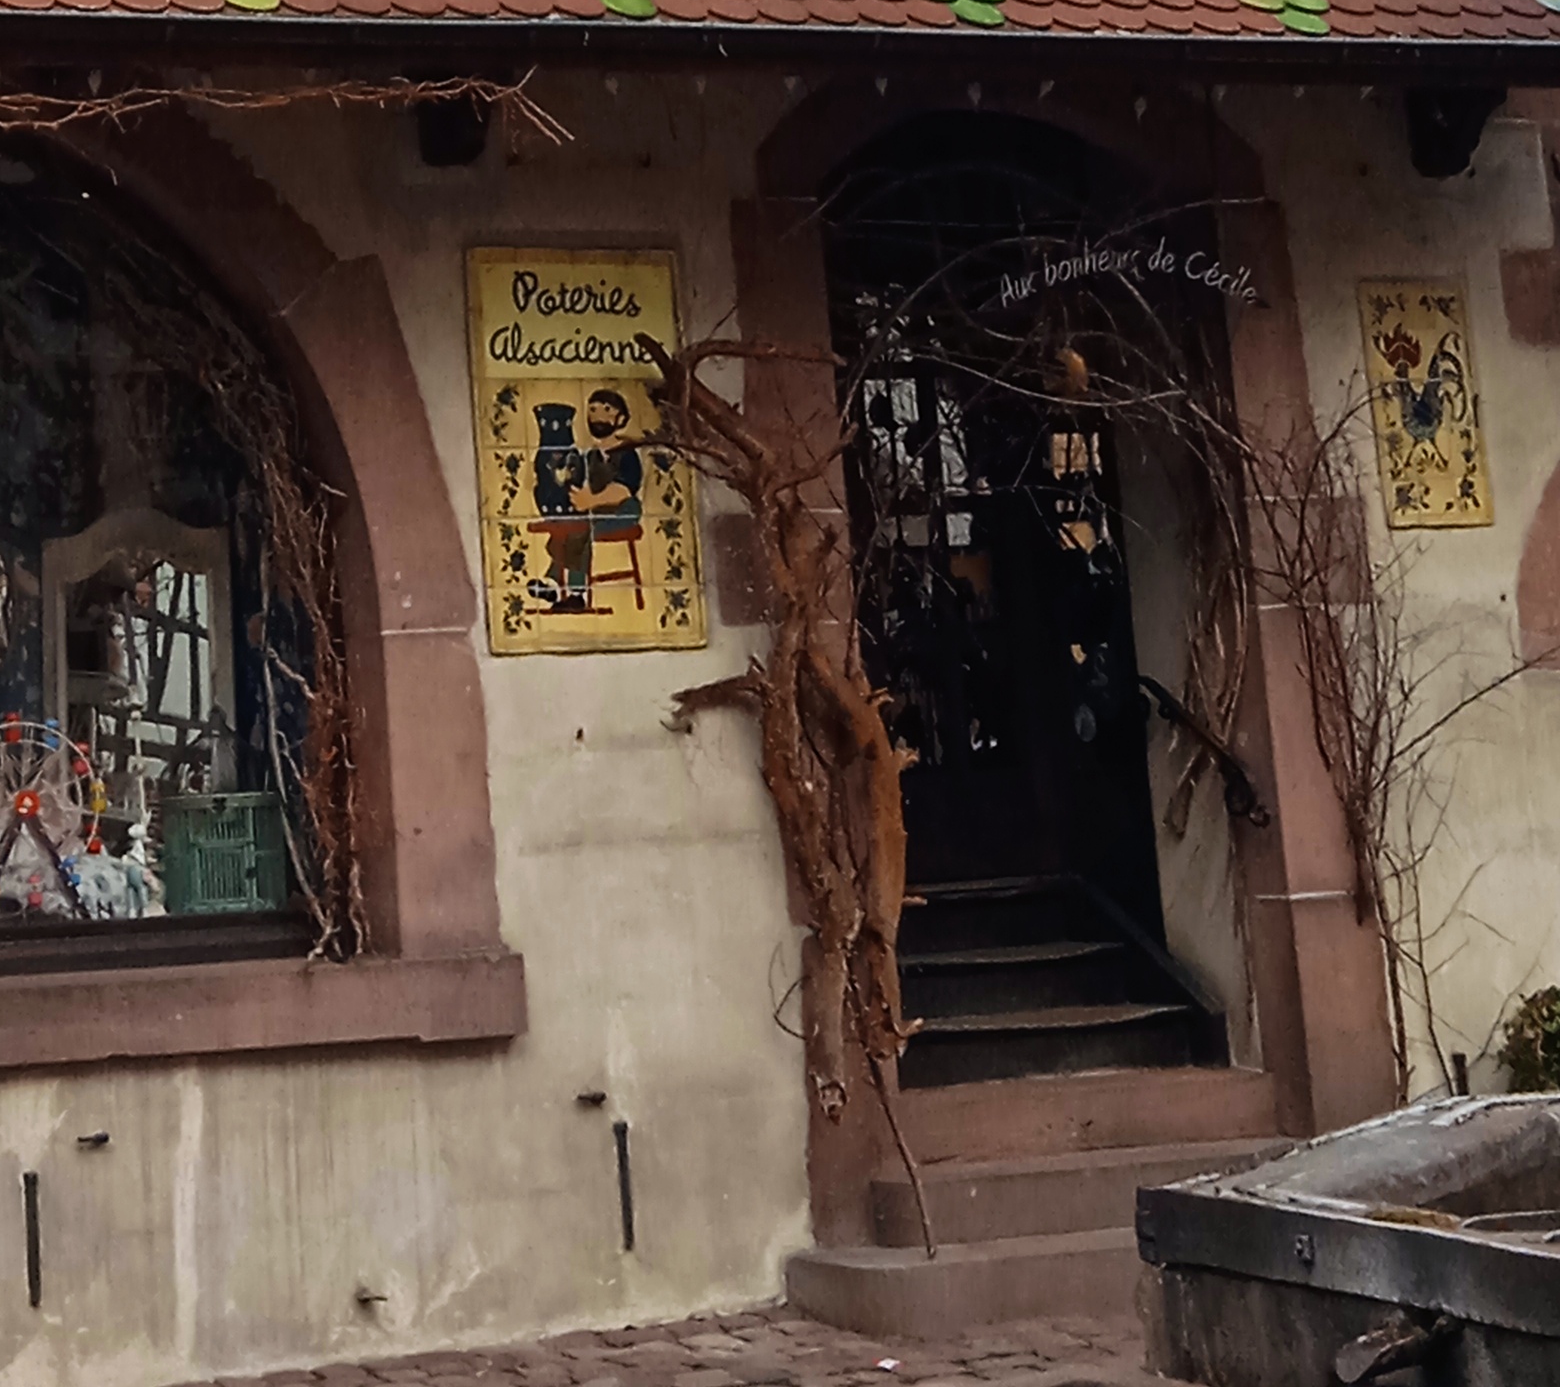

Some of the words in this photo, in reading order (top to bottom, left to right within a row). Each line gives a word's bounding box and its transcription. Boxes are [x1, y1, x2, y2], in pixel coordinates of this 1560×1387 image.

[511, 270, 642, 318] Poteries
[1147, 235, 1176, 274] de
[1184, 250, 1259, 306] Cécile
[490, 321, 664, 366] Alsacienne
